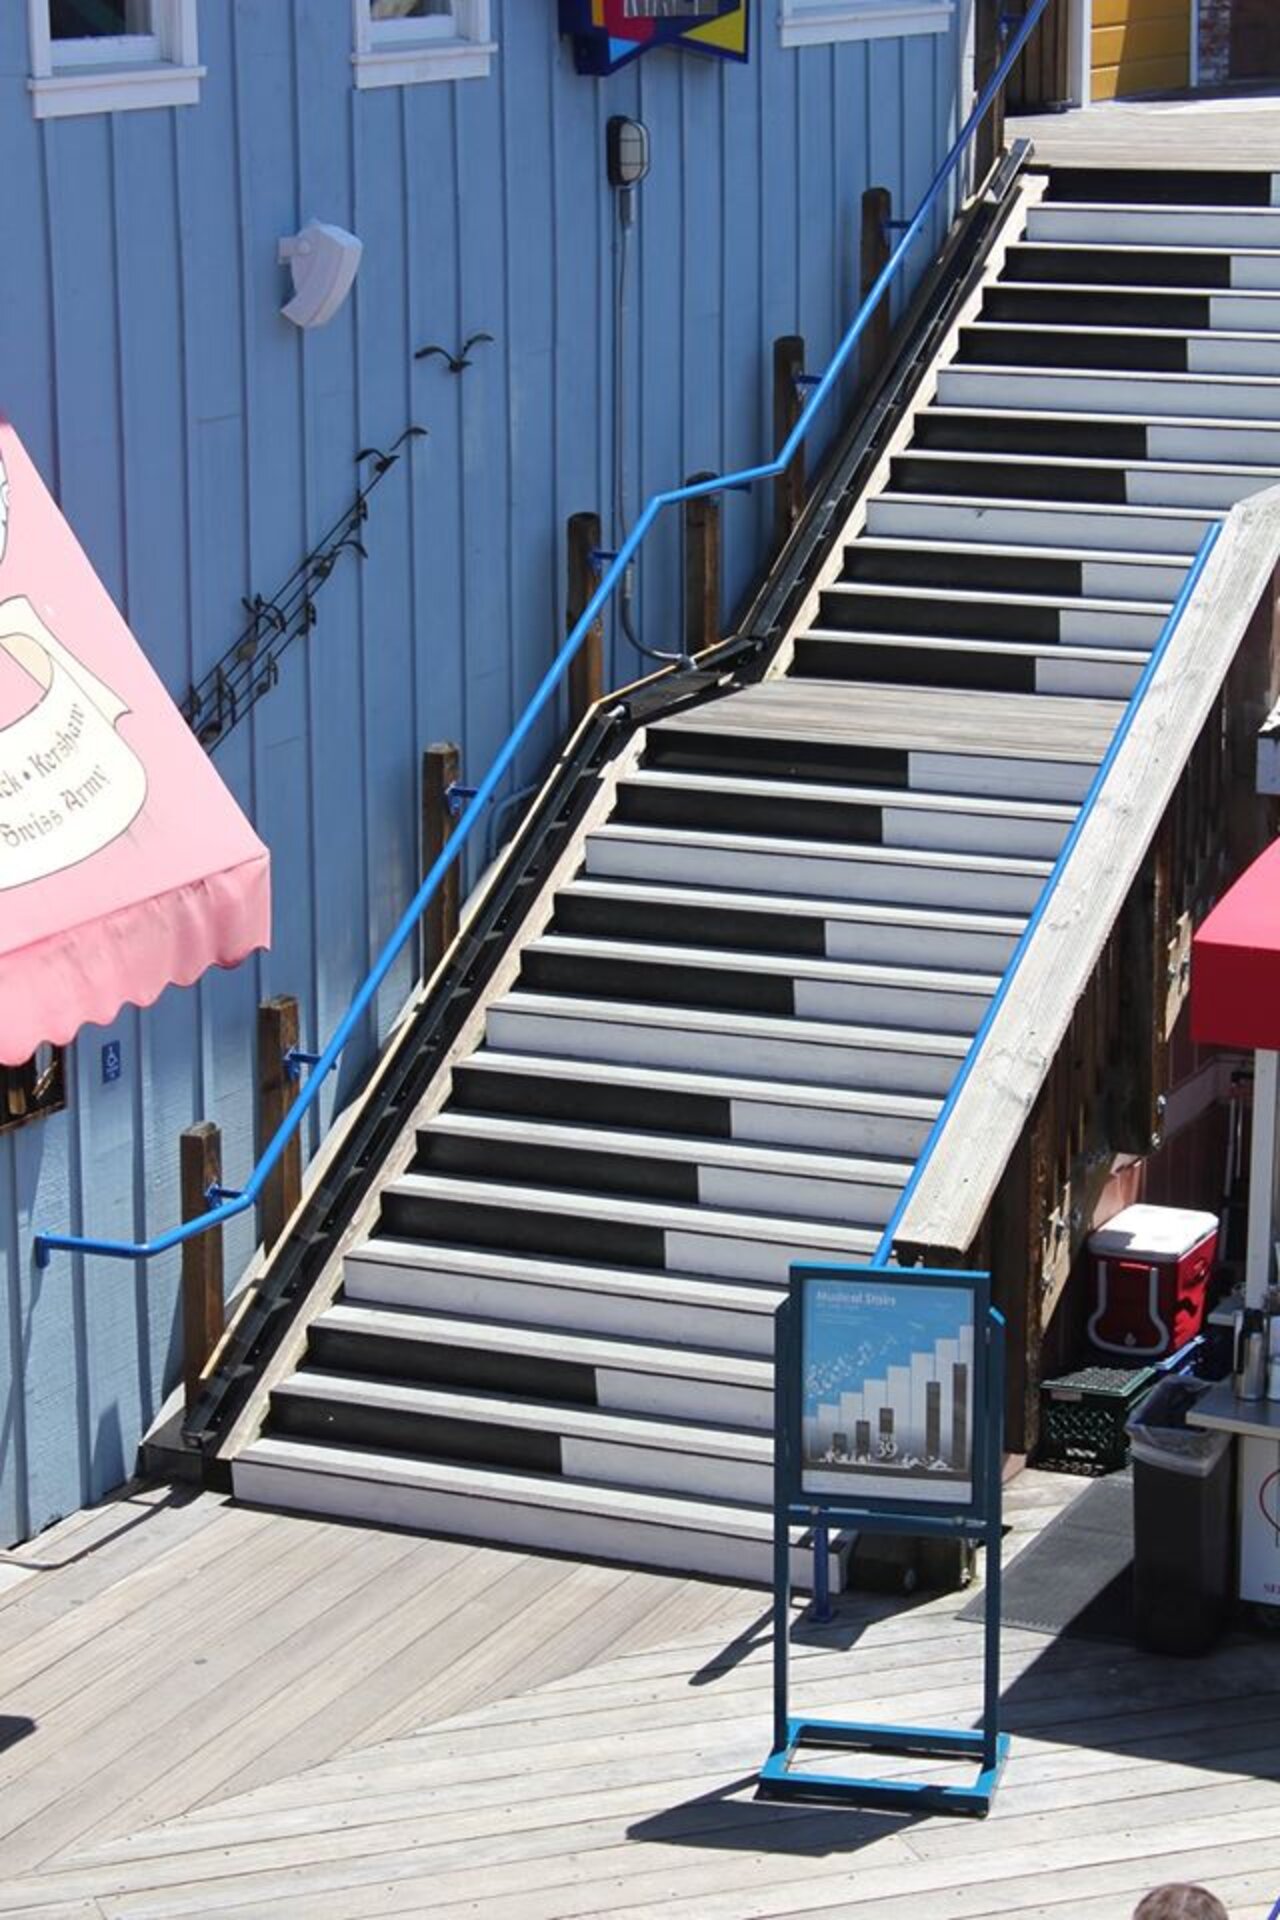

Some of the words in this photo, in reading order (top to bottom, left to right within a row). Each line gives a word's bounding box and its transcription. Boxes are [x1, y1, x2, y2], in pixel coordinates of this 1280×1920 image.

[0, 770, 23, 798] ck
[0, 809, 63, 848] Swiss
[60, 764, 111, 812] Army
[877, 1440, 899, 1459] 39
